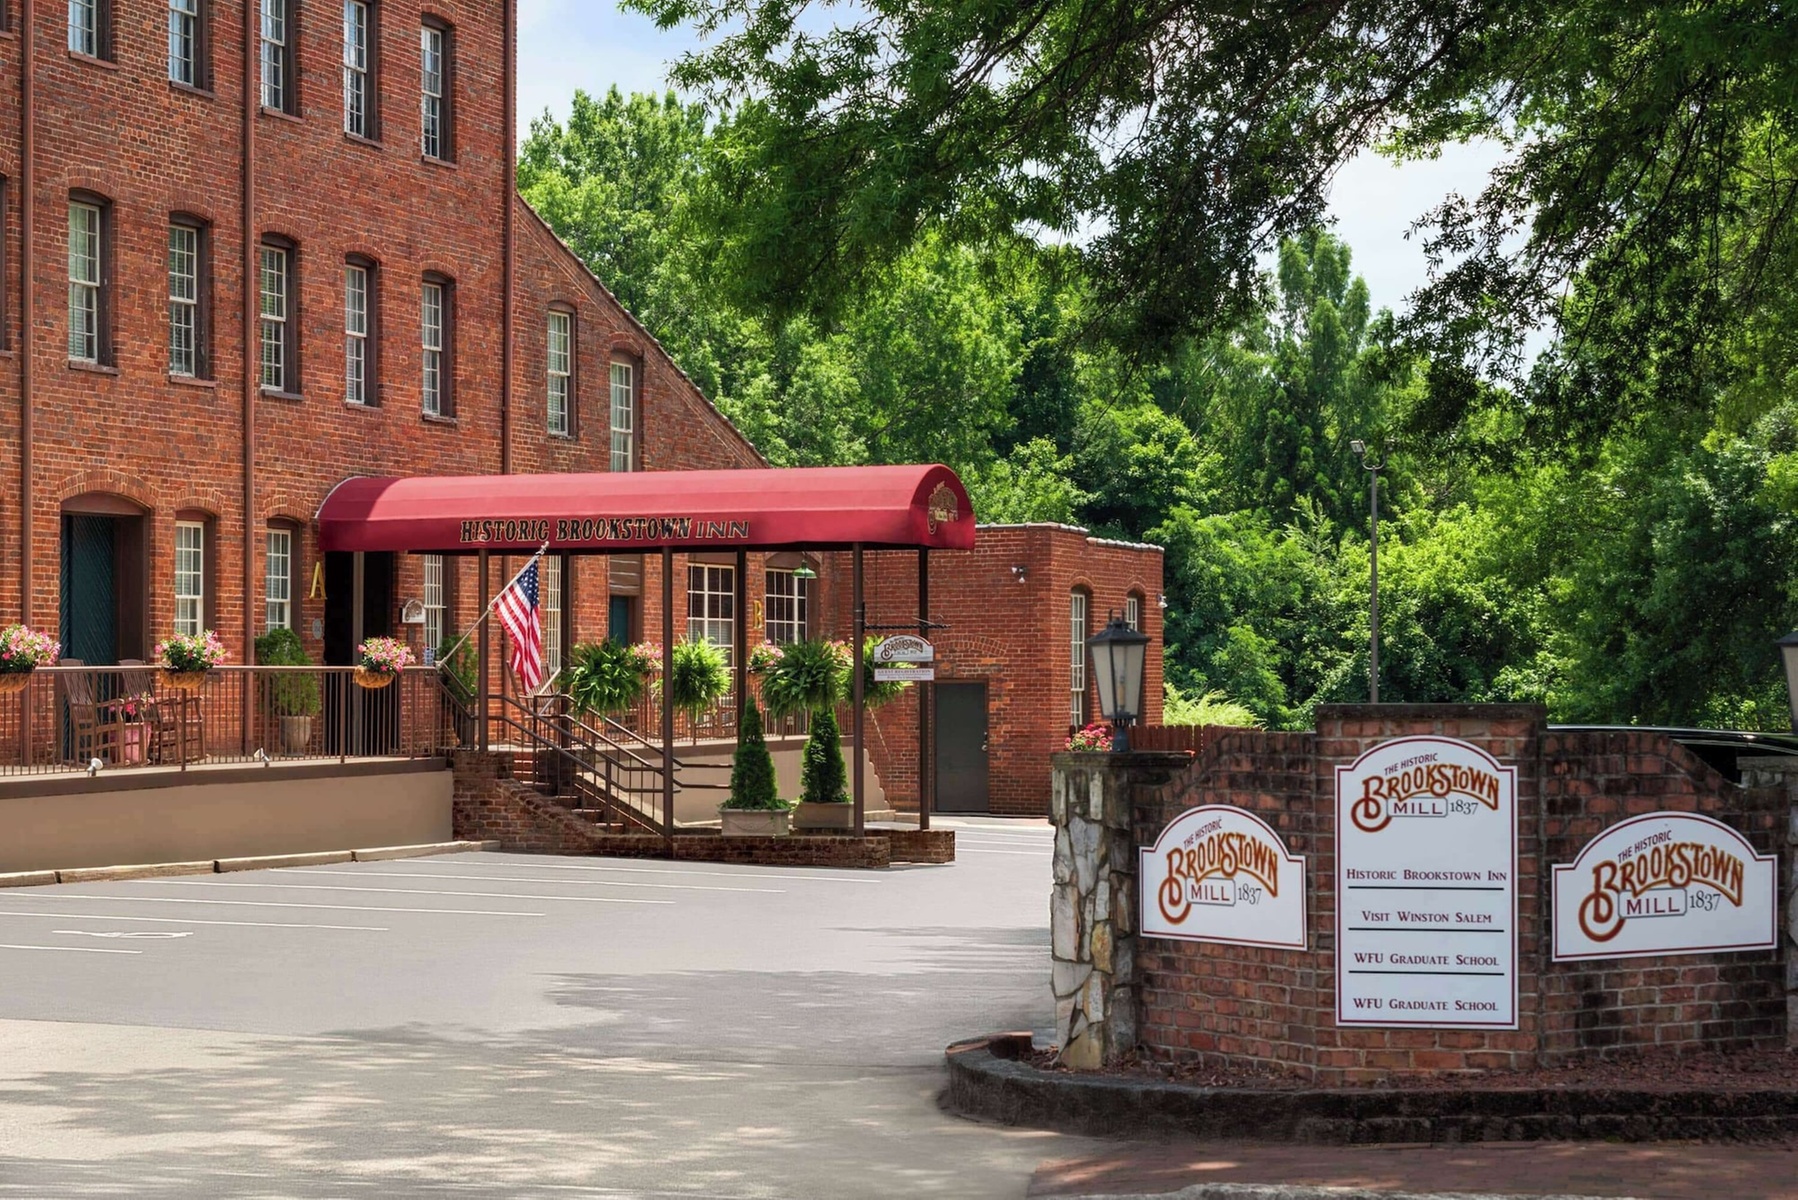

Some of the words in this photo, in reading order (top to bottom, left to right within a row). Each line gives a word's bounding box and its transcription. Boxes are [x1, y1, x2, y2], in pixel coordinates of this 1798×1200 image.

[460, 519, 549, 542] HISTORIC
[556, 517, 692, 541] BROOKSTOWN
[696, 520, 749, 538] INN
[309, 561, 327, 599] A
[753, 600, 763, 629] B
[1384, 762, 1398, 776] THE
[1400, 753, 1438, 768] HISTORIC
[1351, 764, 1499, 833] BROOKSTOWN
[1394, 802, 1443, 815] MILL
[1450, 799, 1479, 815] 1837
[1183, 835, 1194, 850] THE
[1195, 818, 1222, 840] HISTORIC
[1617, 848, 1633, 863] THE
[1634, 830, 1673, 853] HISTORIC
[1158, 832, 1278, 925] BROOKSTOWN
[1346, 868, 1397, 880] HISTORIC
[1403, 869, 1481, 881] BROOKSTOWN
[1487, 870, 1507, 881] INN
[1191, 884, 1230, 901] MILL
[1238, 883, 1262, 905] 1837
[1578, 842, 1744, 943] BROOKSTOWN
[1626, 896, 1680, 915] MILL
[1689, 890, 1721, 911] 1837
[1362, 911, 1390, 922] VISIT
[1397, 911, 1449, 923] WINSTON
[1455, 912, 1492, 923] SALEM
[1354, 953, 1384, 963] WFU
[1390, 953, 1449, 965] GRADUATE
[1456, 954, 1500, 966] SCHOOL
[1353, 998, 1383, 1009] WFU
[1389, 999, 1449, 1010] GRADUATE
[1455, 1000, 1499, 1011] SCHOOL
